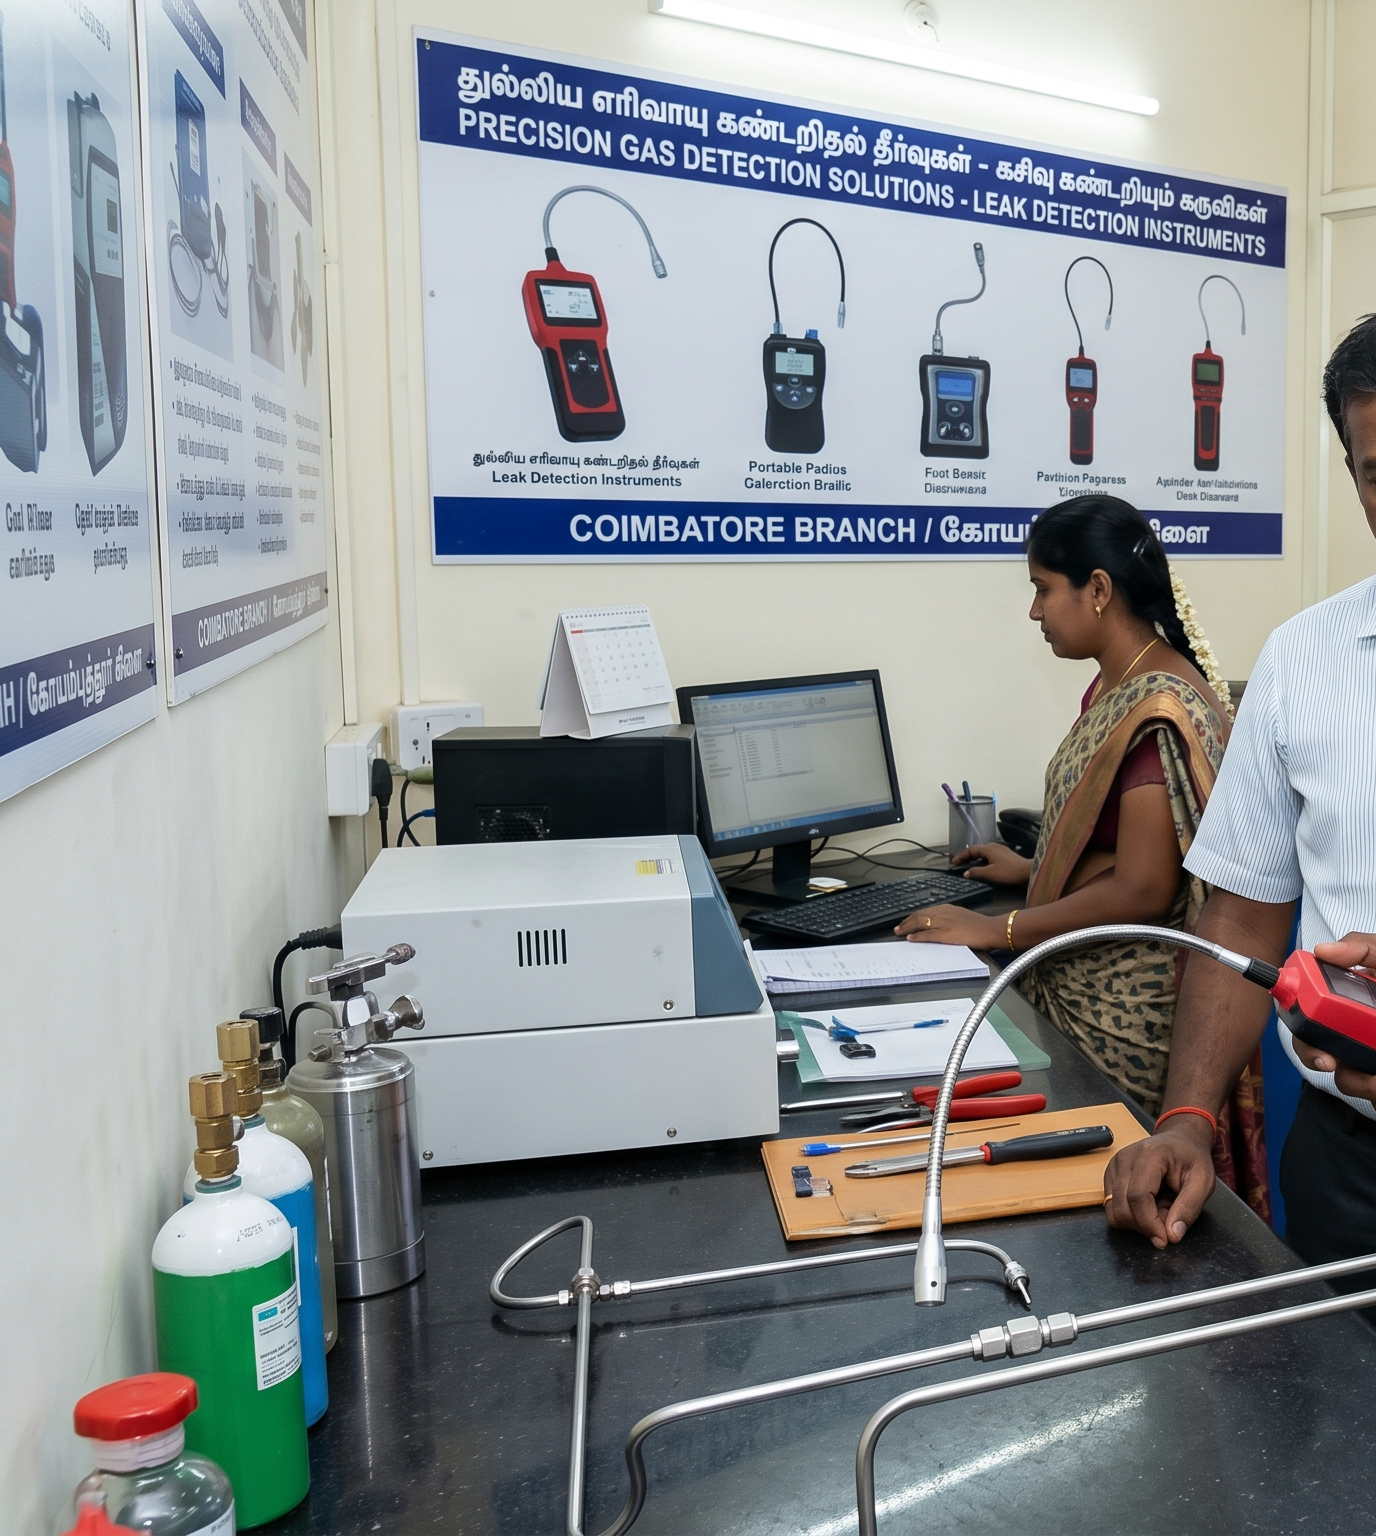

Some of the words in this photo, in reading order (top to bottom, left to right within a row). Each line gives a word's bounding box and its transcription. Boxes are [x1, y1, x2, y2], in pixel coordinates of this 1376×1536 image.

[458, 64, 583, 109] துல்லிய
[592, 86, 709, 137] எரிவாயு
[717, 109, 867, 158] கண்டறிதல்
[873, 129, 972, 174] தீர்வுகள்
[996, 157, 1054, 195] கசிவு
[1059, 169, 1175, 211] கண்டறியும்
[1180, 194, 1268, 224] கருவிகள்
[459, 107, 611, 158] PRECISION
[620, 134, 676, 167] GAS
[683, 143, 821, 189] DETECTION
[828, 167, 954, 209] SOLUTIONS
[973, 189, 1027, 220] LEAK
[1032, 199, 1139, 238] DETECTION
[1144, 218, 1266, 257] INSTRUMENTS
[749, 460, 802, 473] Portable
[492, 471, 527, 484] Leak
[531, 471, 598, 485] Detection
[601, 473, 682, 487] Instruments
[744, 477, 811, 490] Galerction
[1082, 473, 1126, 486] Pagaress
[569, 514, 785, 543] COIMBATORE
[794, 517, 916, 543] BRANCH
[923, 517, 933, 543] /
[197, 607, 243, 649] COIMBATORE
